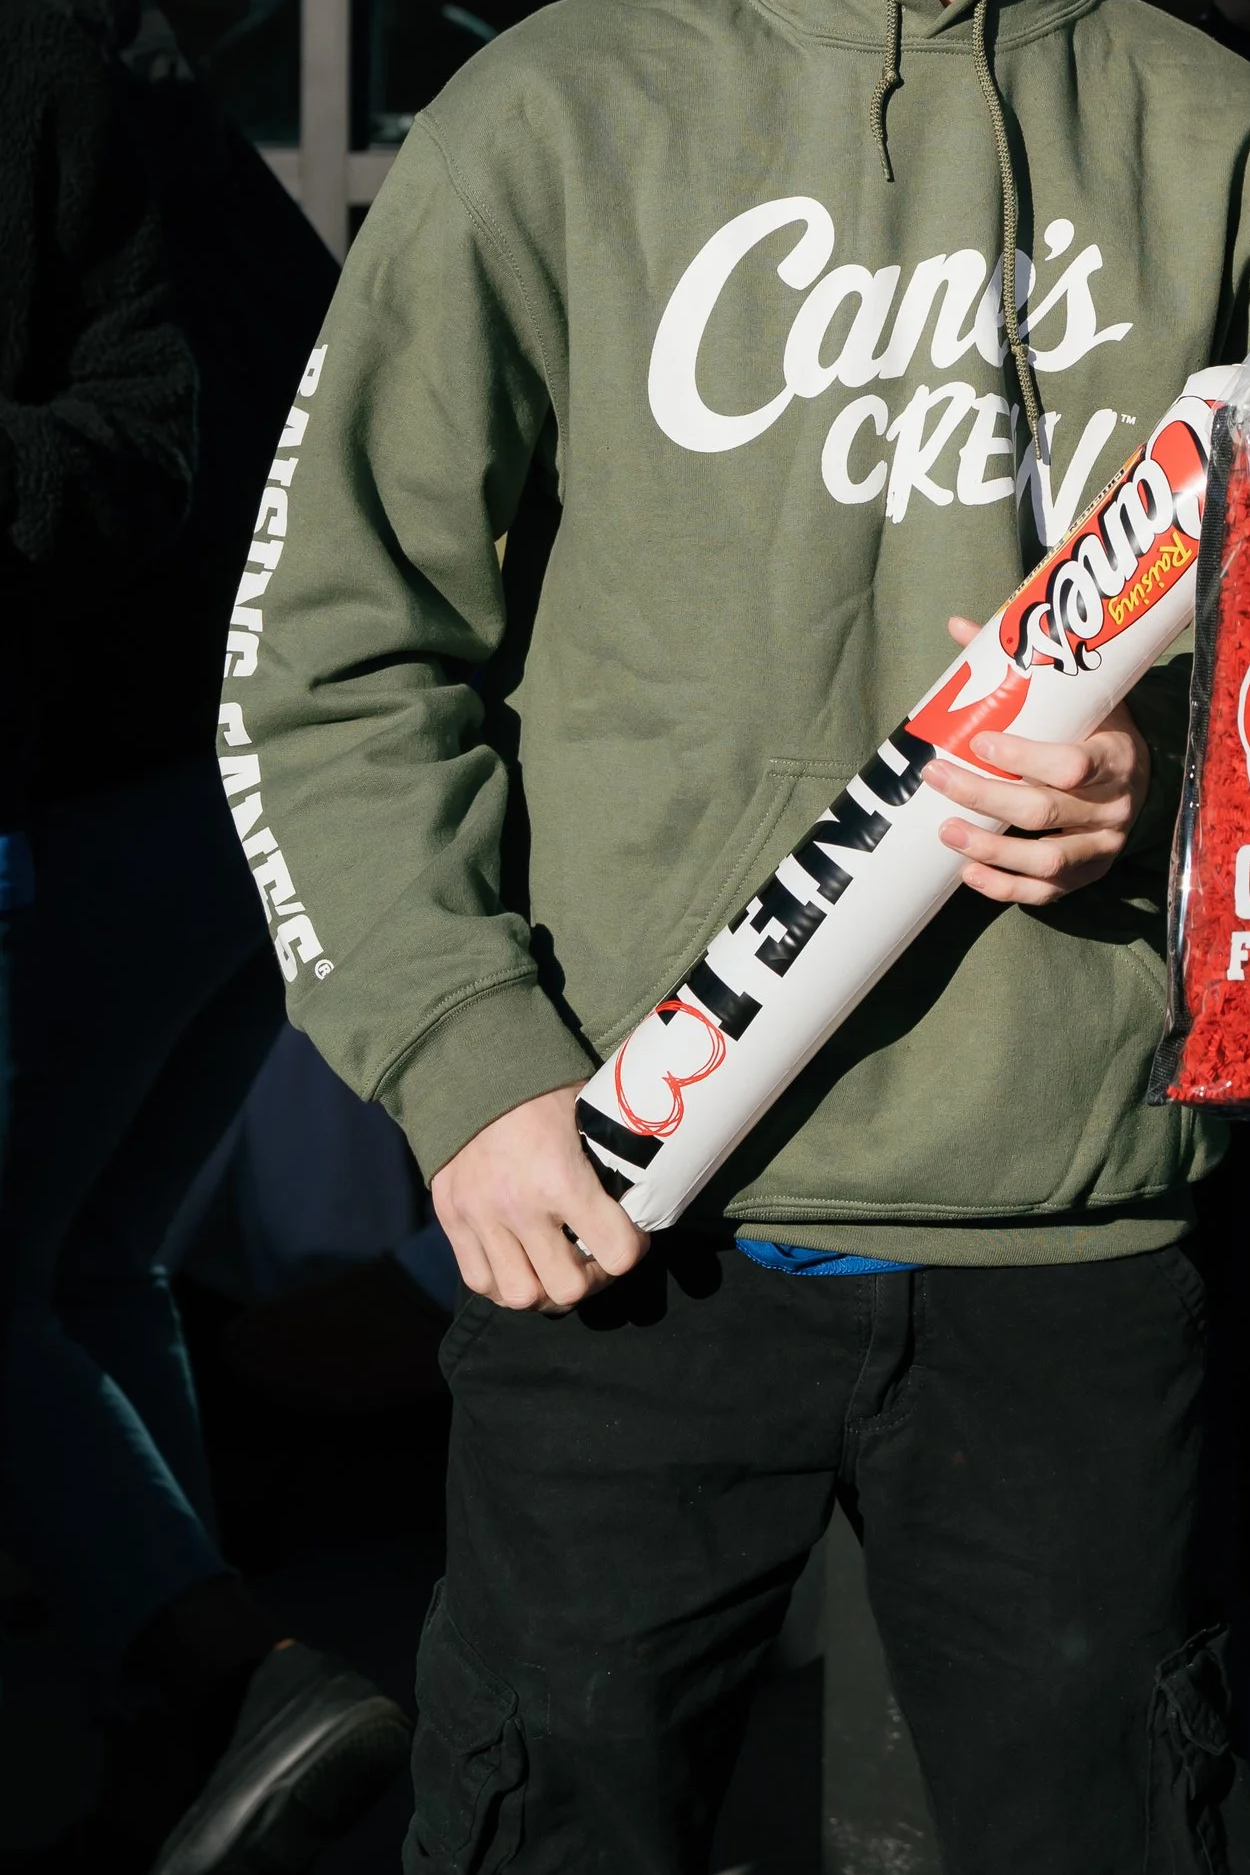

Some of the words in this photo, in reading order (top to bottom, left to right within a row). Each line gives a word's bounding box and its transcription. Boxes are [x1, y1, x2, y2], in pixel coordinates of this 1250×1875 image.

[648, 196, 1133, 453] Cane's
[821, 381, 1116, 547] CREW
[1016, 396, 1214, 676] Cane's
[1108, 530, 1192, 625] Raising
